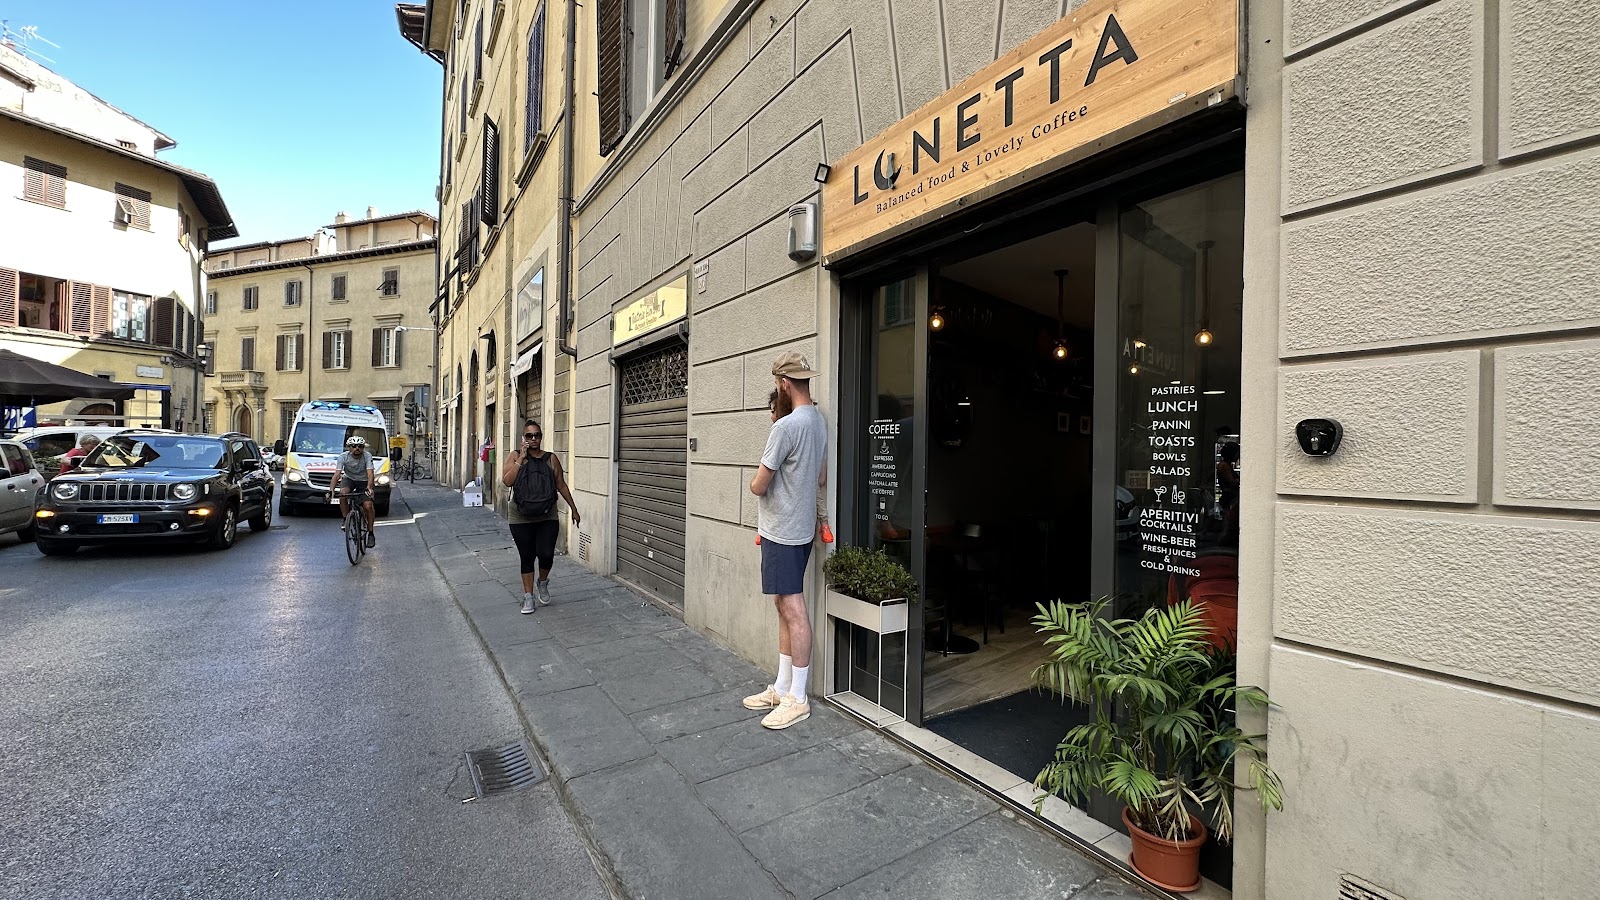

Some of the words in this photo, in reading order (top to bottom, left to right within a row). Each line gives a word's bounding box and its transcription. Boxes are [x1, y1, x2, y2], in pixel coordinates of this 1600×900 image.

[875, 182, 924, 215] Balanced
[928, 165, 955, 189] food
[961, 160, 970, 173] &
[976, 134, 1024, 166] Lovely
[1031, 105, 1088, 140] Coffee
[1151, 385, 1195, 396] PASTRIES
[1148, 400, 1198, 413] LUNCH
[868, 423, 901, 435] COFFEE
[1152, 420, 1191, 431] PANINI
[1148, 436, 1195, 447] TOASTS
[1152, 453, 1186, 462] BOWLS
[870, 471, 897, 479] CAPPUCCINO
[1149, 466, 1191, 477] SALADS
[1140, 508, 1199, 524] APERITIVI
[1140, 519, 1193, 533] COCKTAILS
[1140, 532, 1197, 548] WINE-BEER
[1142, 544, 1168, 555] FRESH
[1168, 547, 1197, 559] JUICES
[1163, 554, 1172, 563] &
[1140, 560, 1165, 571] COLD
[1166, 564, 1201, 577] DRINKS
